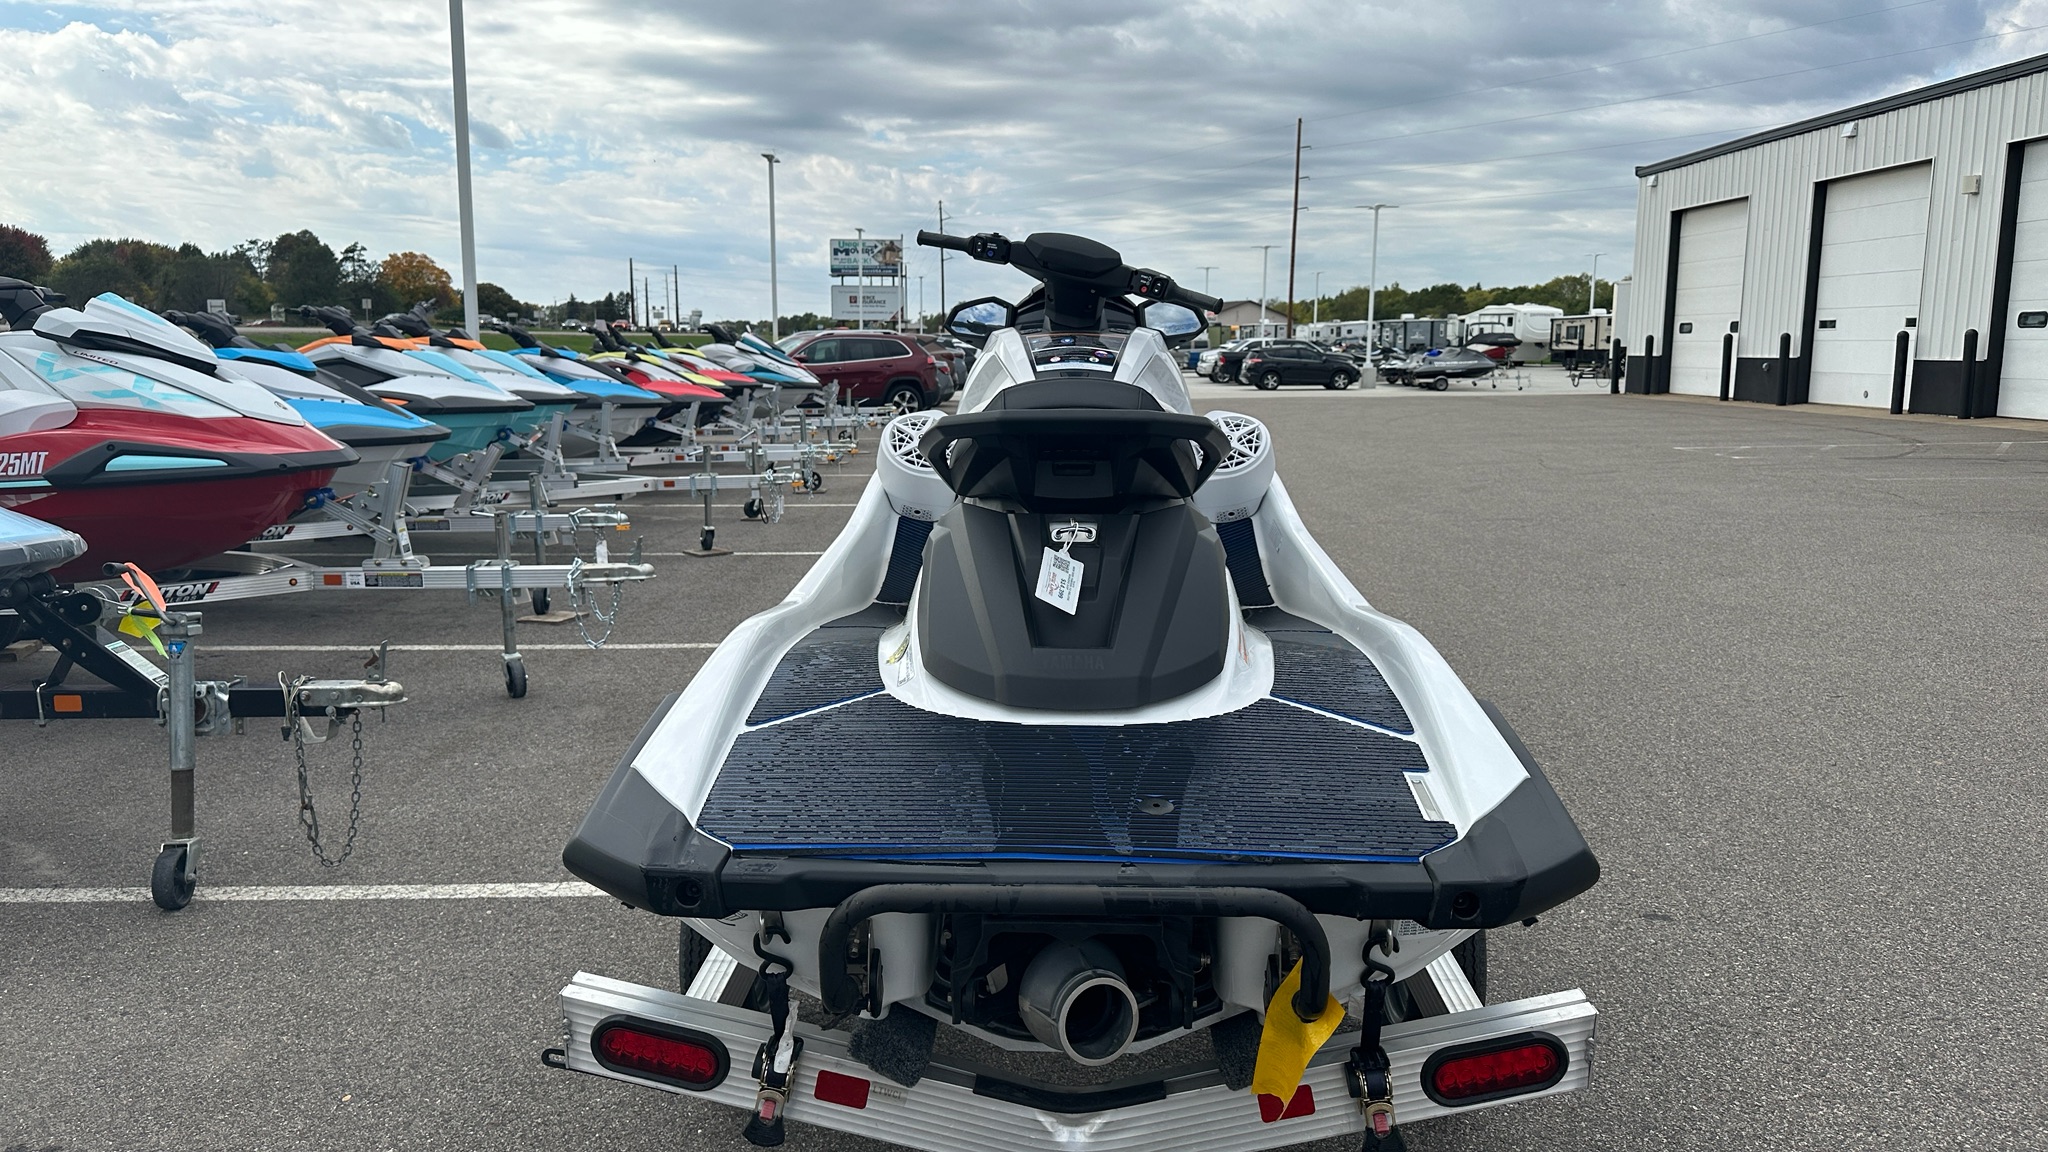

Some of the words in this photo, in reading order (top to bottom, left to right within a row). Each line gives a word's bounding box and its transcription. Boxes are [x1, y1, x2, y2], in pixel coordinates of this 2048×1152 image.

[73, 350, 119, 365] LIMITED
[0, 451, 49, 476] 25MT
[129, 582, 211, 603] TITON
